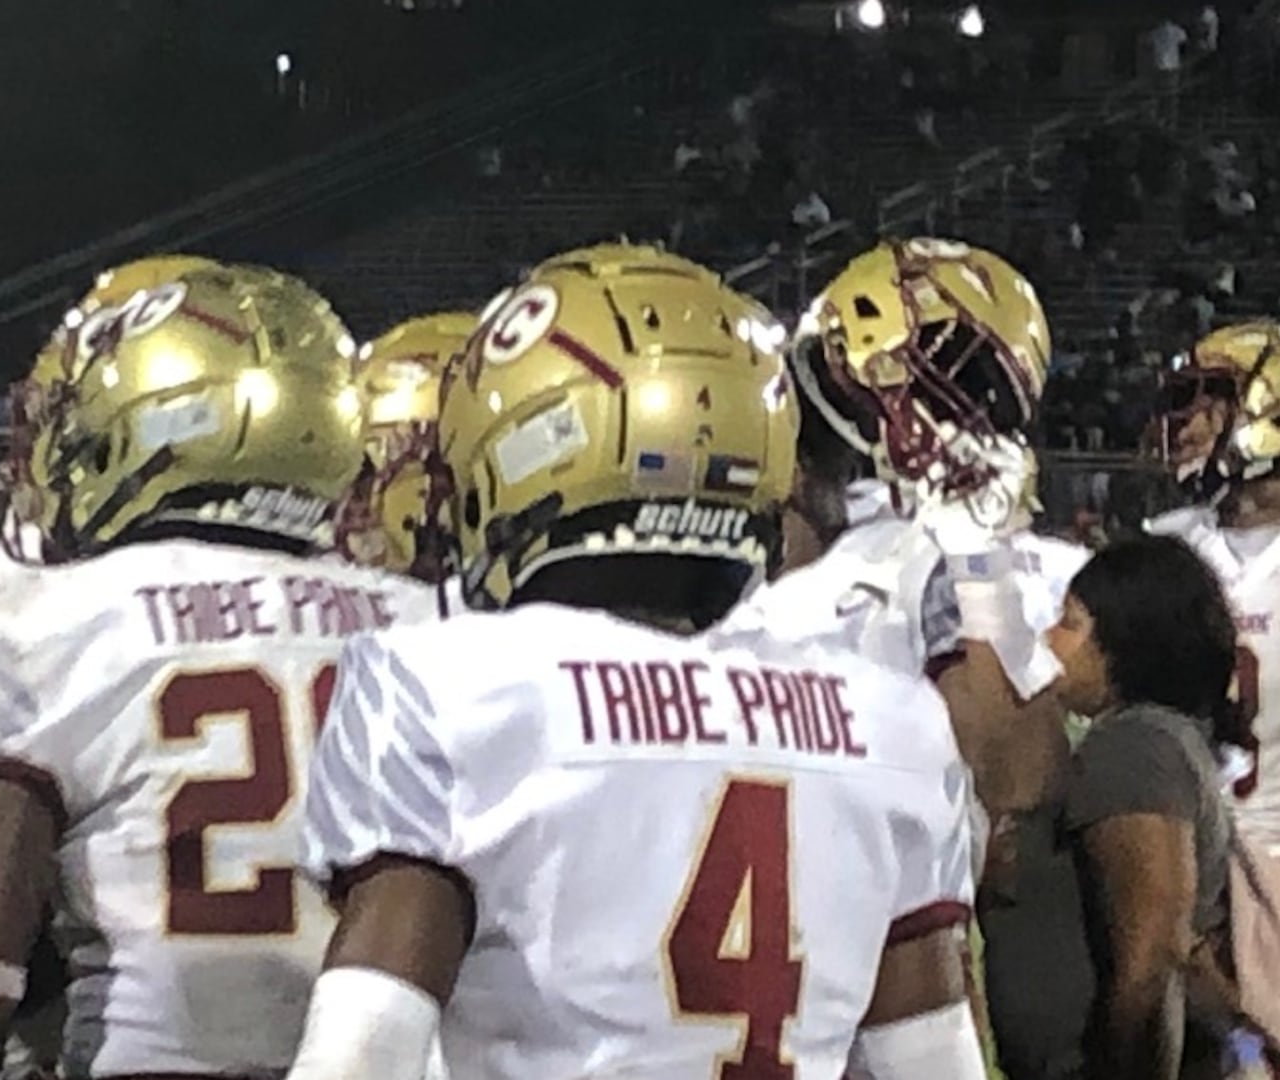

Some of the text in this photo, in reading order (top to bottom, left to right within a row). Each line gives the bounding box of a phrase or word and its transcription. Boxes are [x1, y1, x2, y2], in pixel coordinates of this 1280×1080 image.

[132, 575, 277, 645] TRIBE
[558, 660, 868, 758] TRIBE PRIDE
[153, 660, 338, 938] 2
